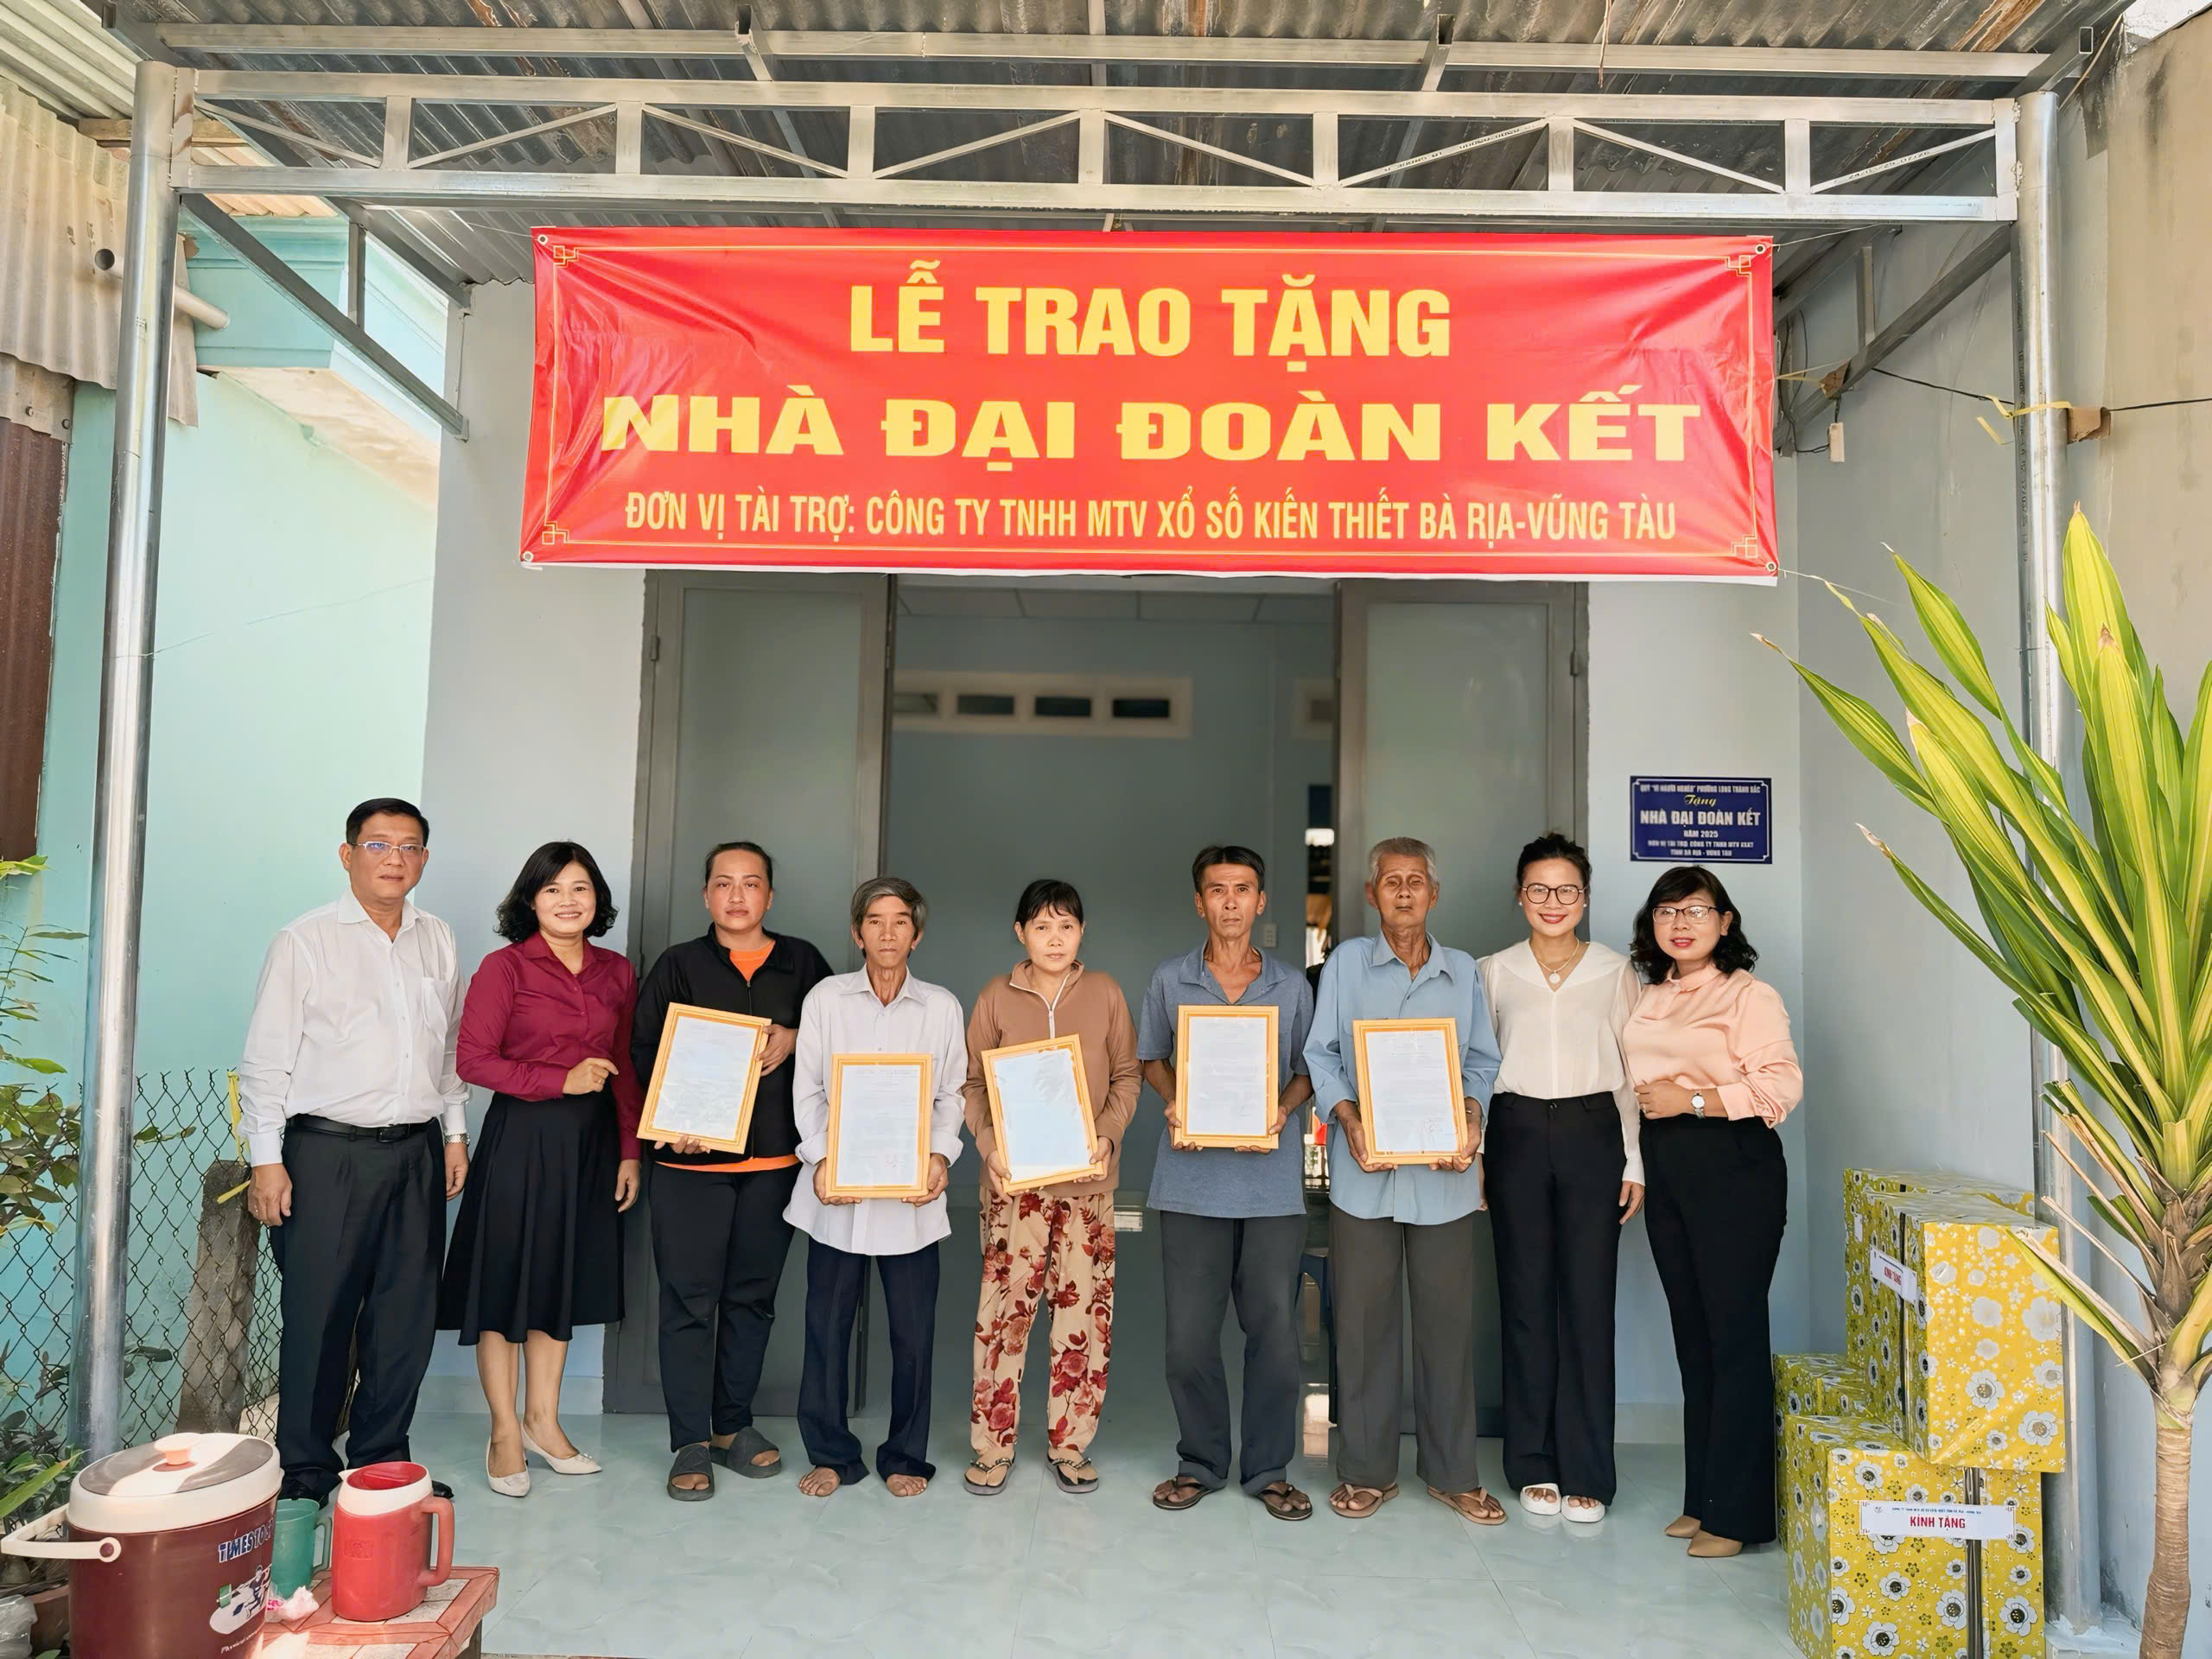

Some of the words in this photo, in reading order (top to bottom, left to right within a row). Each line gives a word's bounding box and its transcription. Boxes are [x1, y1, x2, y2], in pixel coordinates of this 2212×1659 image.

[850, 259, 944, 353] LỄ
[975, 286, 1191, 357] TRAO
[1221, 273, 1451, 373] TẶNG
[601, 385, 844, 455] NHÀ
[880, 399, 1075, 471] ĐẠI
[1116, 390, 1441, 461] ĐOÀN
[1486, 384, 1701, 461] KẾT
[625, 490, 687, 530] ĐƠN
[697, 493, 725, 540] VỊ
[734, 486, 779, 532] TÀI
[789, 494, 855, 542] TRỢ:
[866, 490, 944, 536] CÔNG
[954, 498, 990, 536] TY
[999, 499, 1077, 537] TNHH
[1088, 499, 1147, 537] MTV
[1157, 486, 1195, 539] XỔ
[1205, 486, 1243, 539] SỐ
[1254, 486, 1318, 539] KIẾN
[1328, 486, 1410, 539] THIẾT
[1420, 493, 1456, 540] BÀ
[1467, 494, 1609, 549] RỊA-VŨNG
[1620, 493, 1675, 540] TÀU
[1640, 808, 1668, 824] NHÀ
[1670, 810, 1694, 827] ĐẠI
[1697, 809, 1733, 825] ĐOÀN
[1737, 807, 1761, 826] KẾT
[1910, 1514, 1936, 1528] KÍNH
[1938, 1516, 1966, 1531] TẶNG
